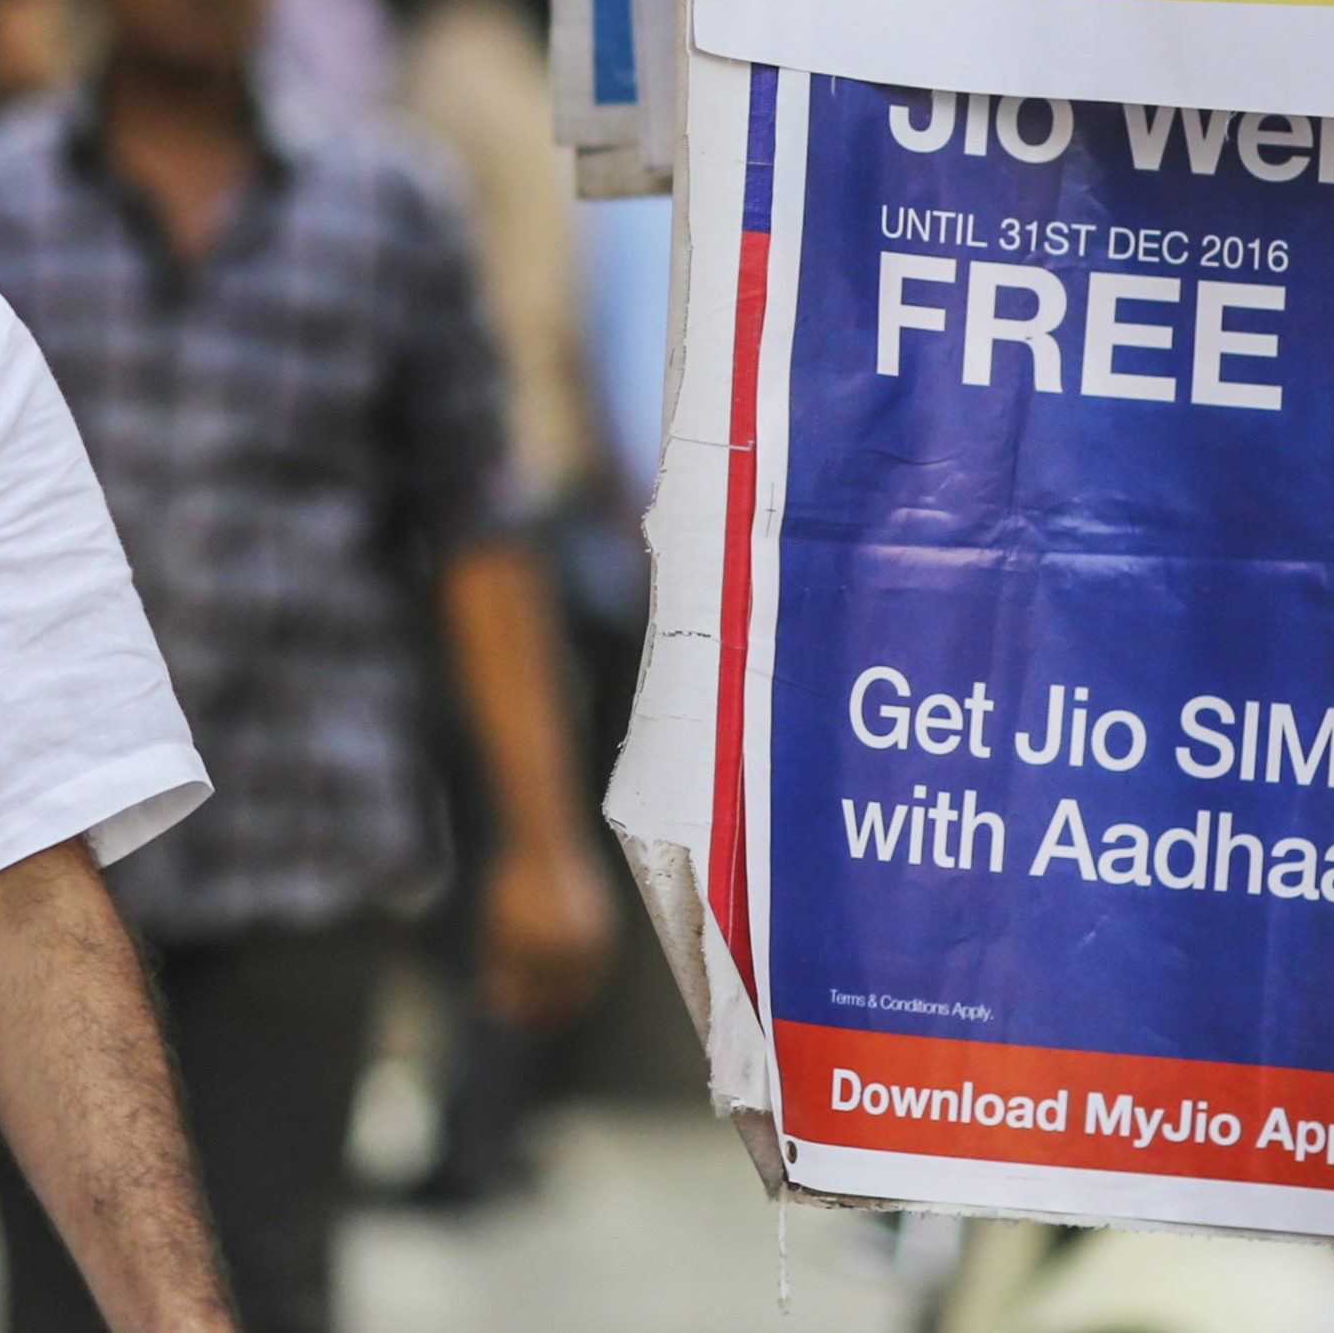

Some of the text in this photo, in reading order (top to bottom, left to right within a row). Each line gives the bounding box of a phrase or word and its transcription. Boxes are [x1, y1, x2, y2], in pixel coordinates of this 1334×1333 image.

[882, 205, 1288, 271] UNTIL 31ST DEC 2016
[876, 250, 1288, 411] FREE
[850, 666, 994, 758] Get
[1015, 685, 1146, 771] Jio
[842, 785, 1005, 872] with
[830, 988, 994, 1022] Terms & Conditions Apply.
[832, 1069, 1068, 1131] Download
[1085, 1092, 1241, 1148] MyJio
